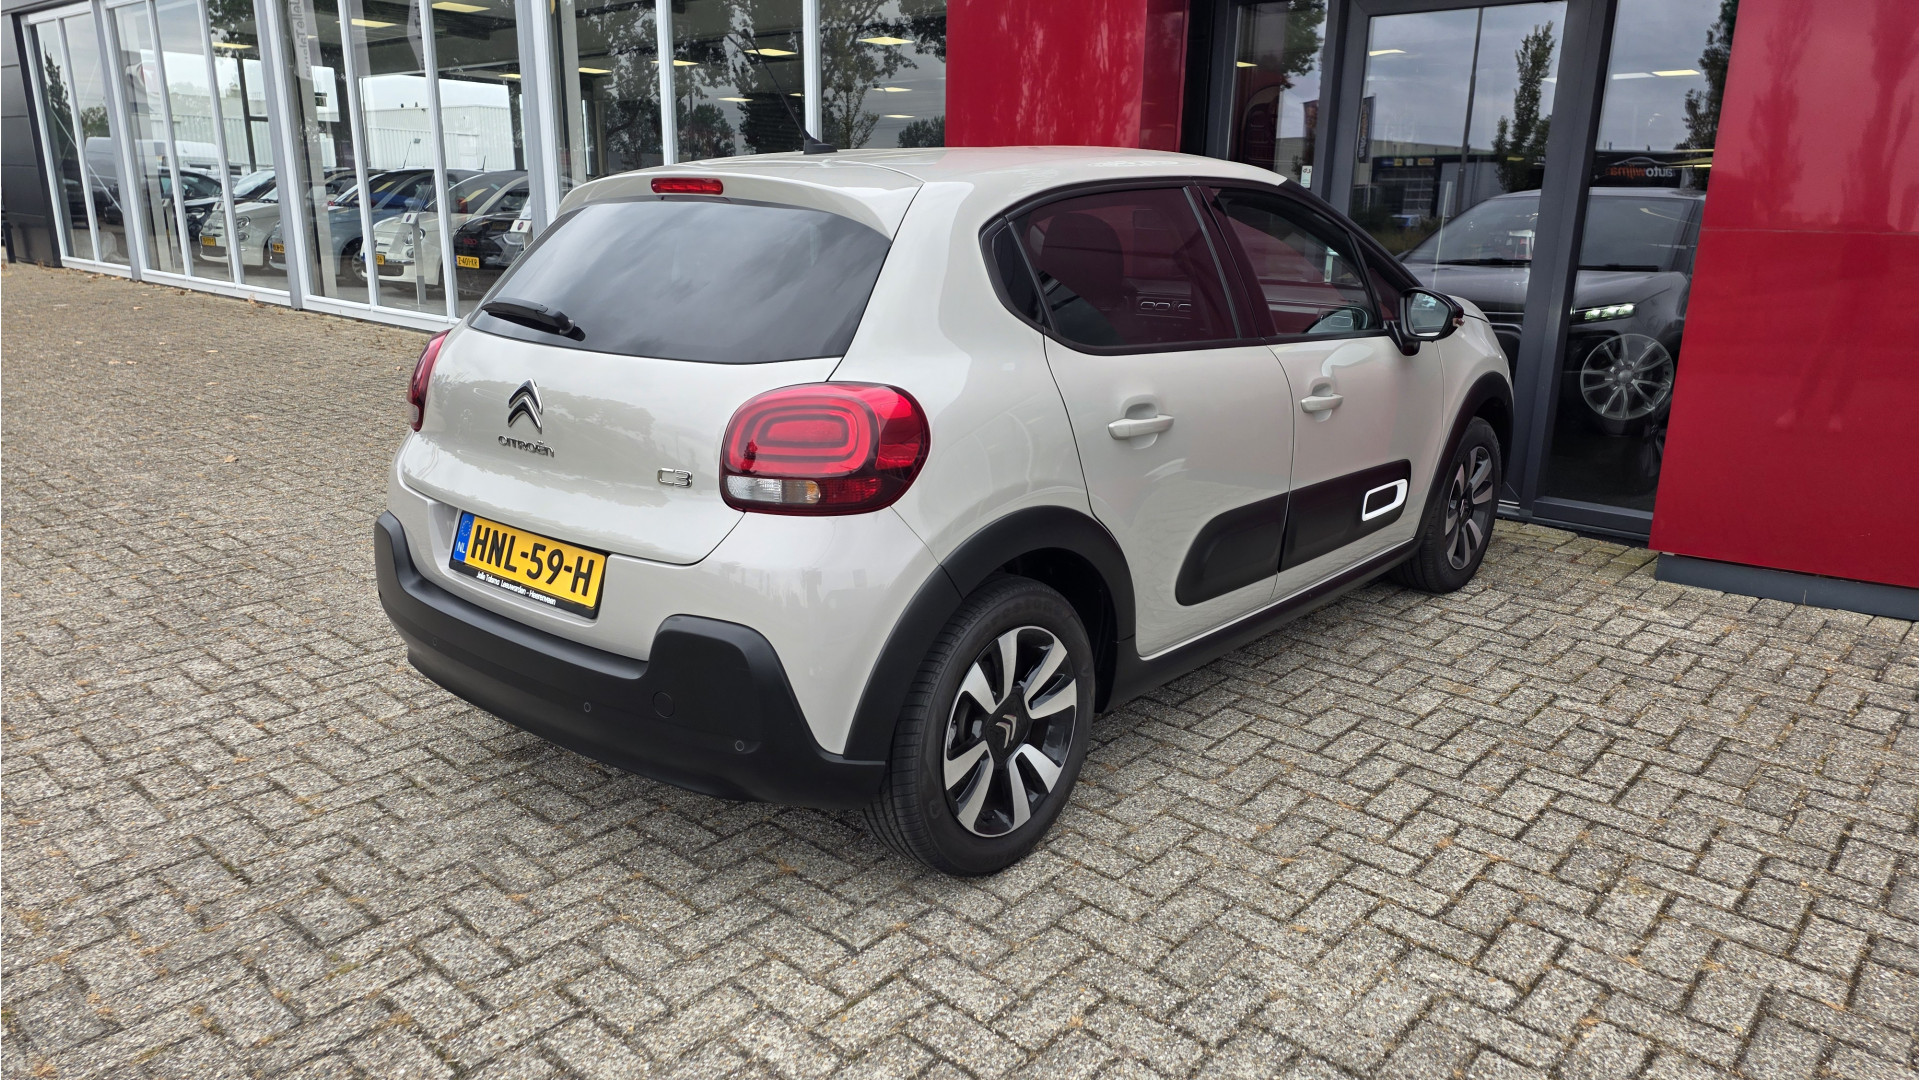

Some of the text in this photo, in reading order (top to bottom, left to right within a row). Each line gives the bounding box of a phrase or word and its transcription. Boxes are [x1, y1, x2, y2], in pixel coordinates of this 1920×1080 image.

[657, 468, 693, 488] C3
[456, 541, 466, 554] NL
[471, 525, 595, 597] HNL-59-H
